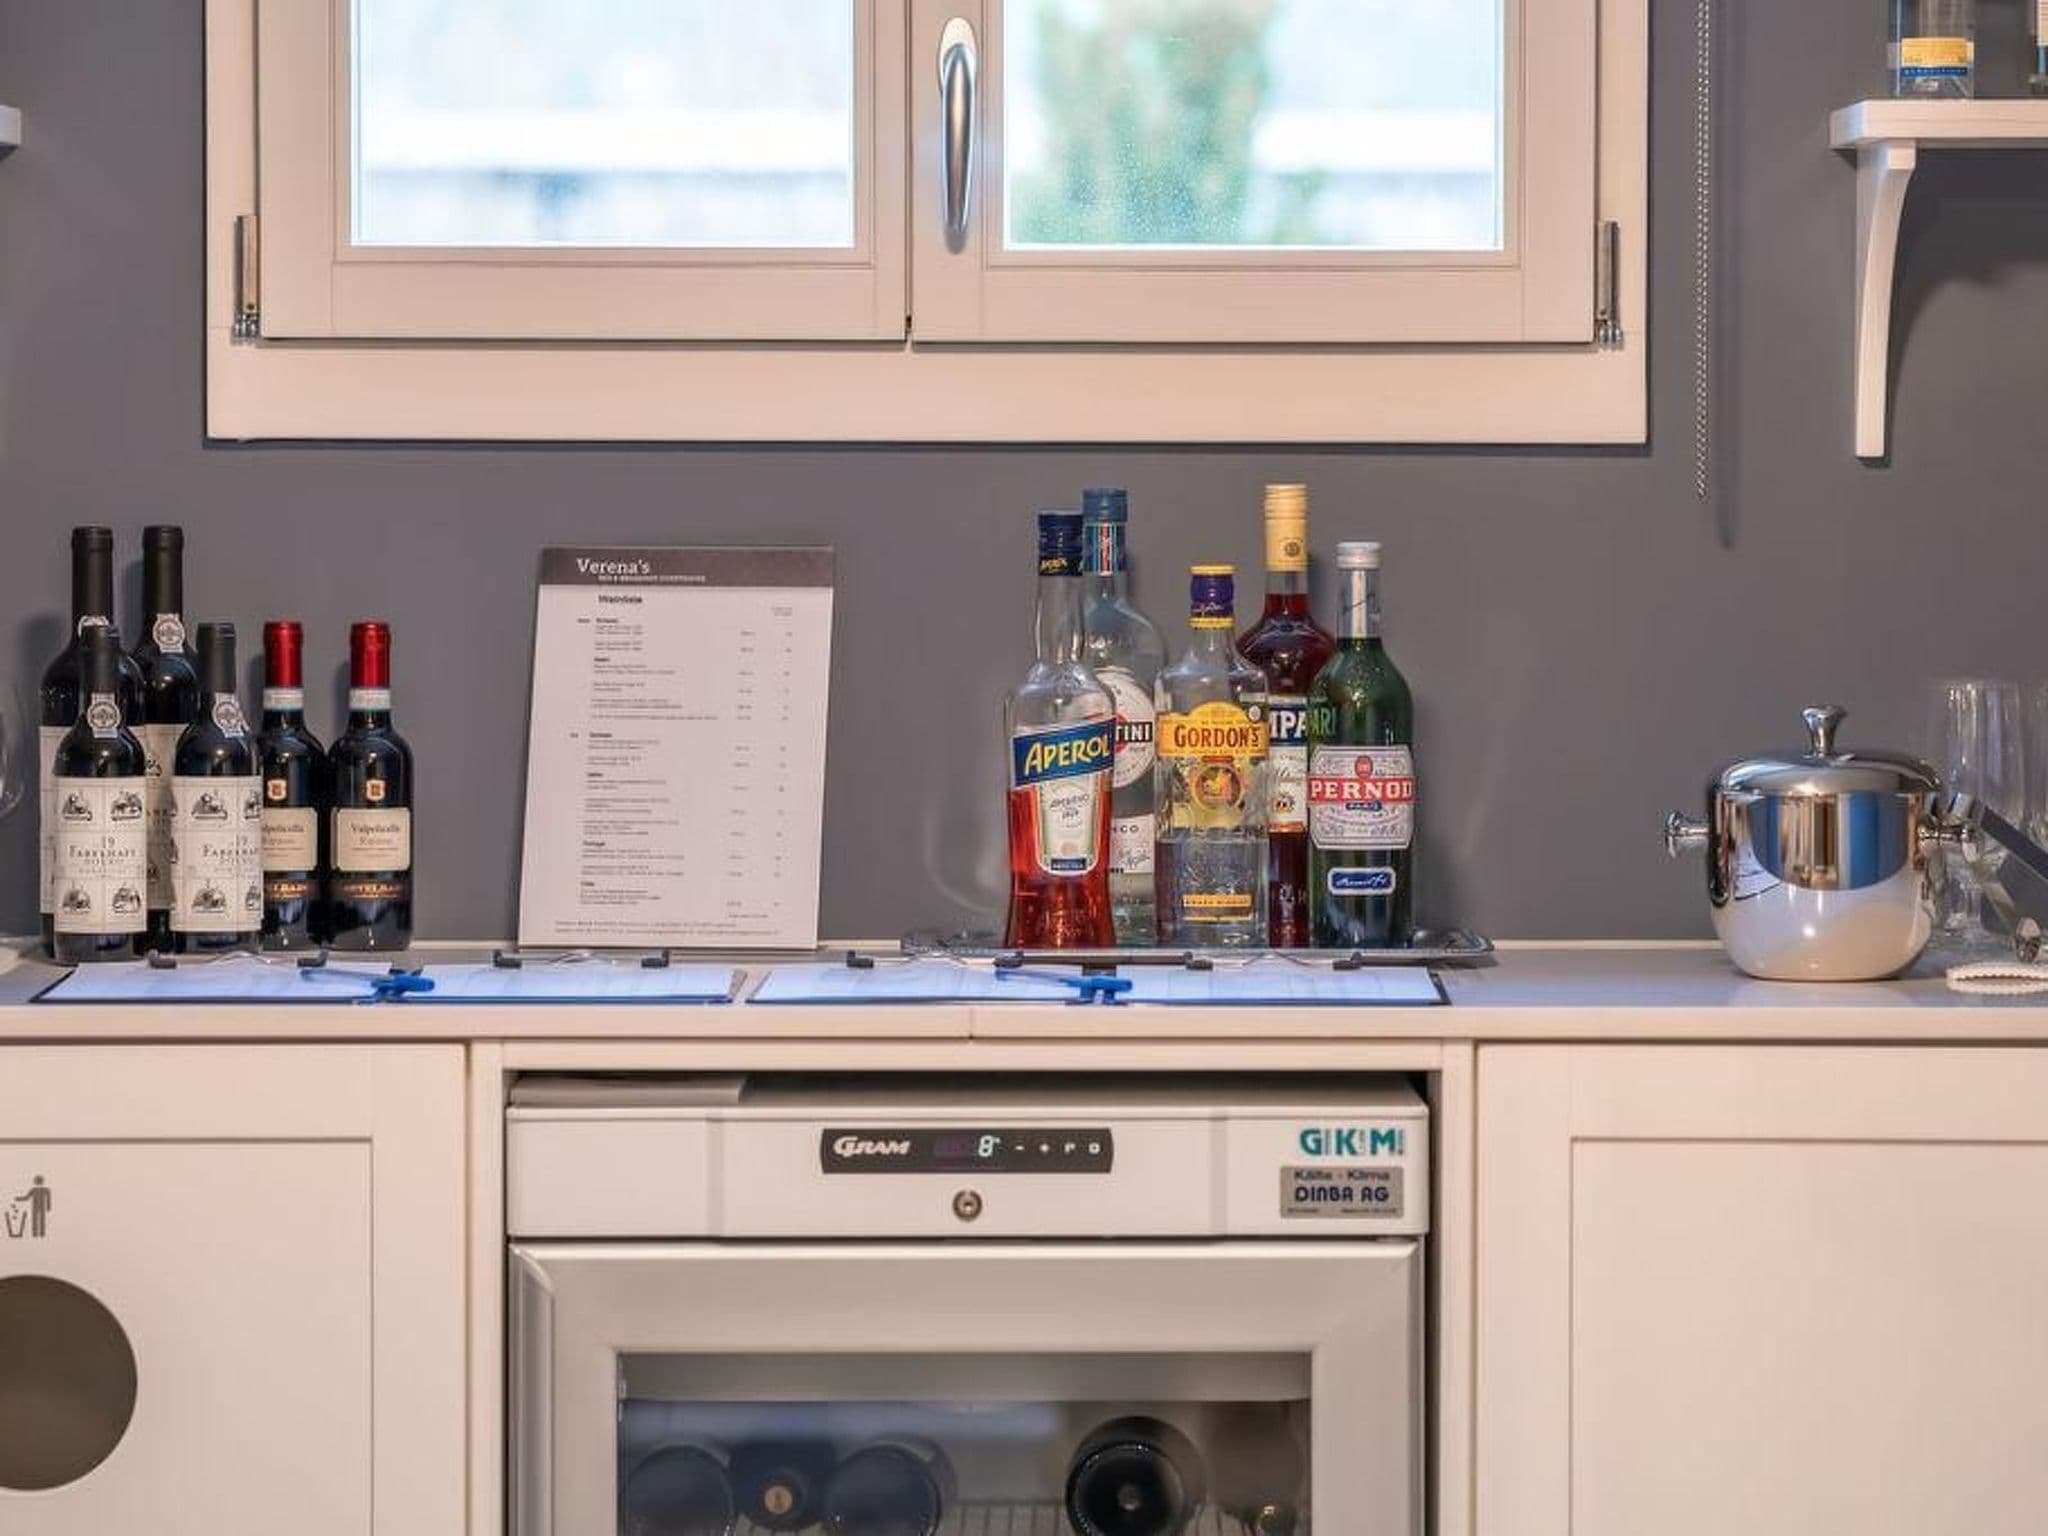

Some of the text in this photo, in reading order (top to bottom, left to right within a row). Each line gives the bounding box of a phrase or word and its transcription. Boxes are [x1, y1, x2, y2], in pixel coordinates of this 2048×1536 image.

[576, 557, 651, 575] Verena's
[1115, 723, 1151, 742] TINI
[1023, 734, 1111, 777] APEROL
[833, 1136, 911, 1157] GRAM
[1361, 1186, 1389, 1202] AG
